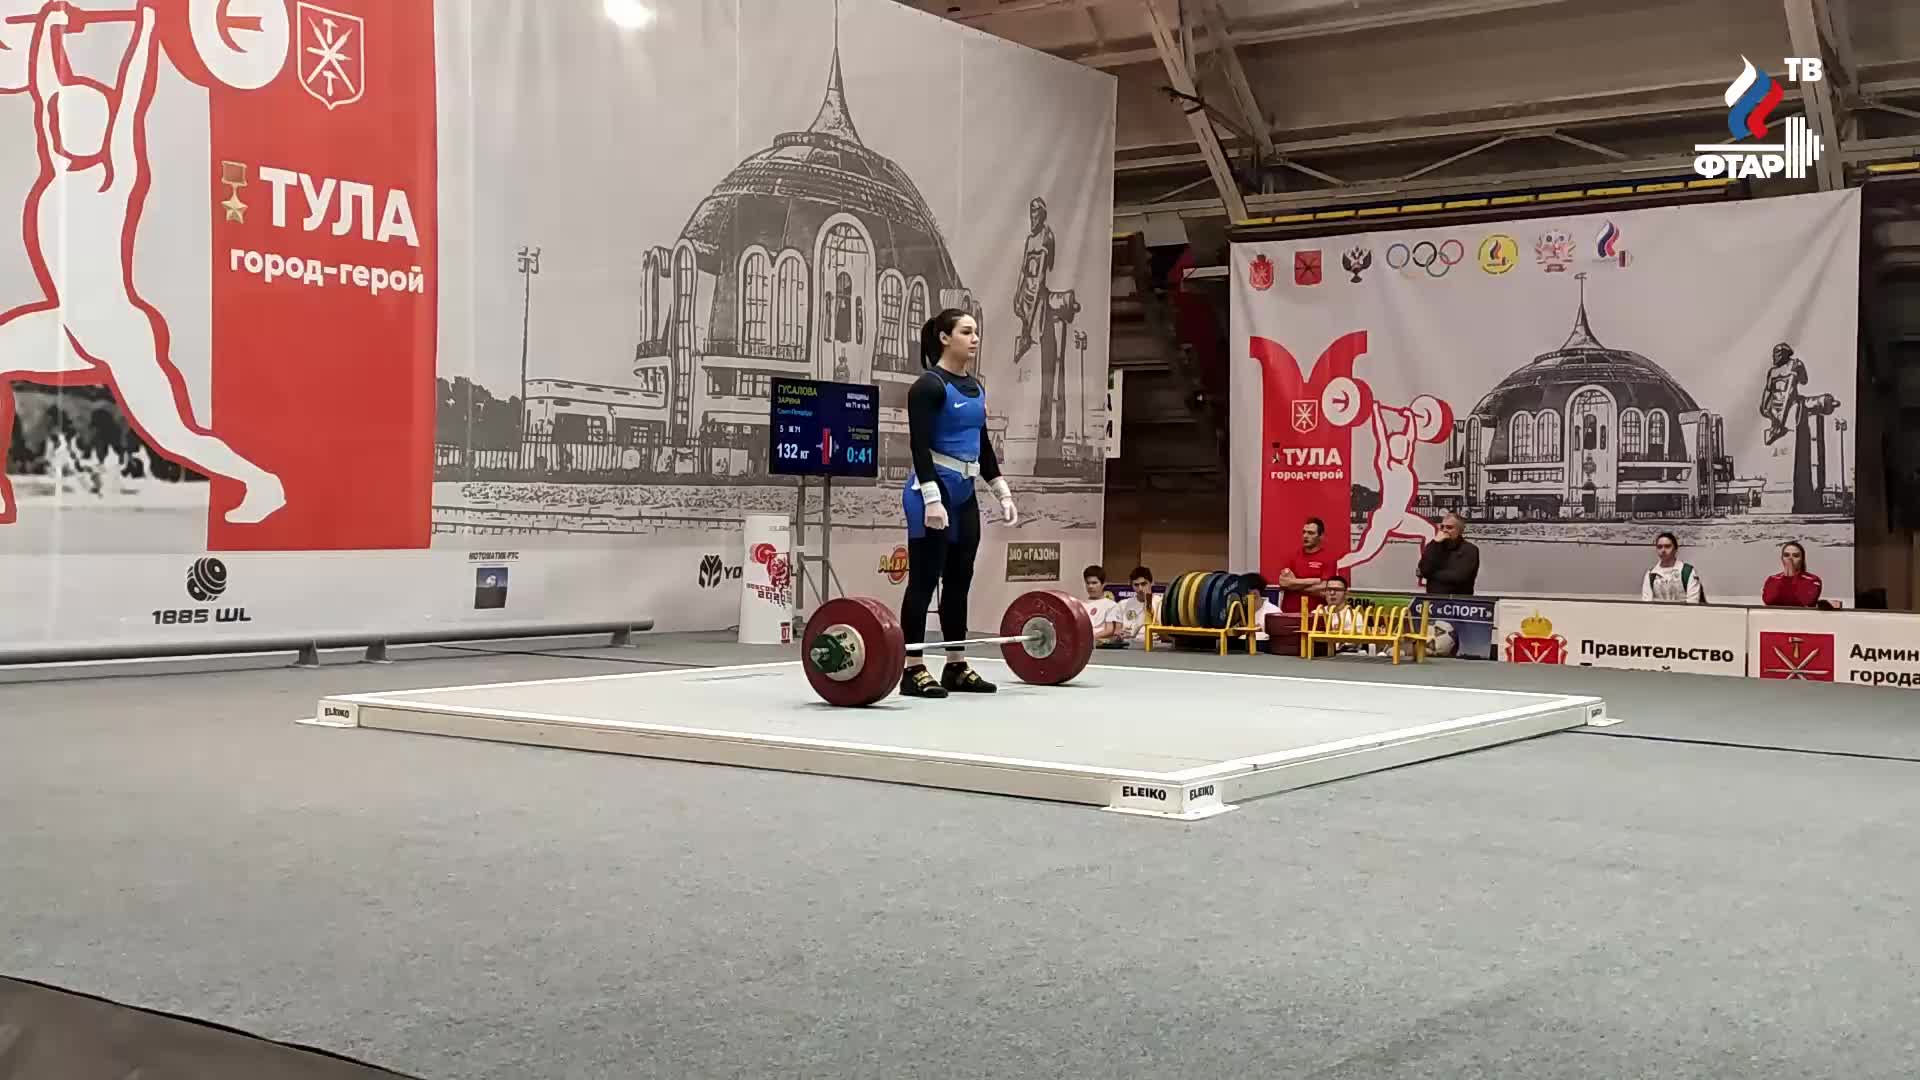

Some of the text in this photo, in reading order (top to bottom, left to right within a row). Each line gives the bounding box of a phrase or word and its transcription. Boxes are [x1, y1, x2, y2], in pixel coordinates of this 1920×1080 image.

[259, 166, 420, 248] ТУЛА
[230, 248, 424, 296] город-герой
[777, 443, 798, 459] 132
[846, 447, 872, 464] 0:41
[1283, 447, 1343, 466] ТУЛА
[1271, 469, 1344, 481] город-герой
[152, 608, 209, 625] 1885
[1581, 639, 1734, 663] Правительство
[1849, 643, 1920, 663] Админ
[1849, 669, 1920, 687] города
[1122, 784, 1215, 801] ELEIKO ELEIKO
